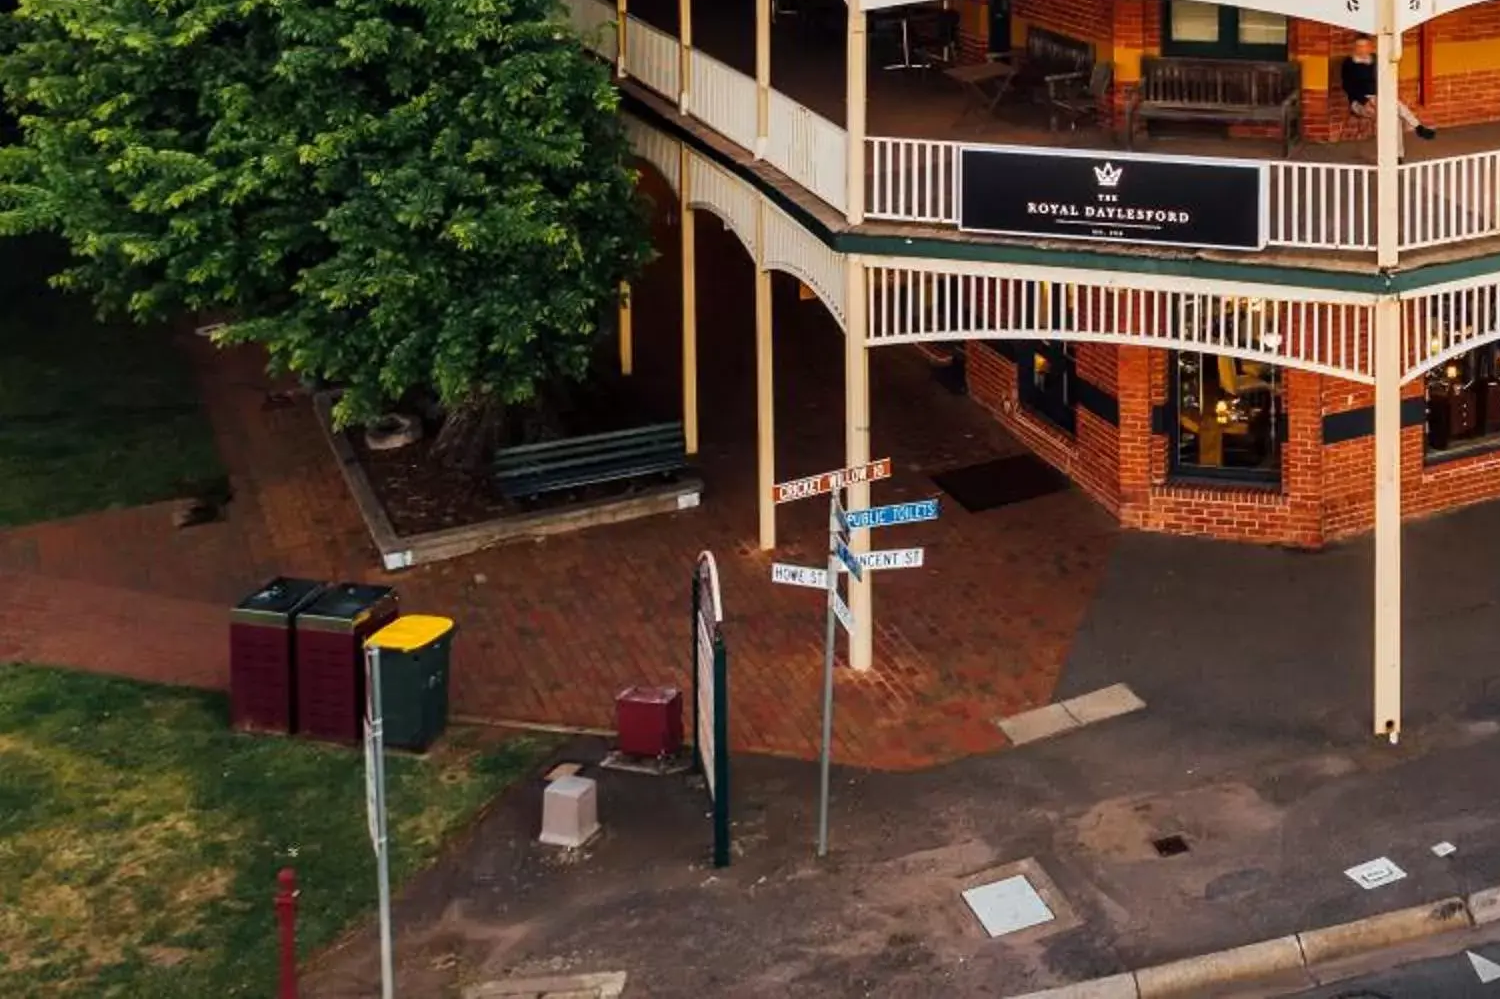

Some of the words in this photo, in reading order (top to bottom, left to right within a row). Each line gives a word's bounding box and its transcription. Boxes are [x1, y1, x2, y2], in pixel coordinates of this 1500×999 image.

[1026, 202, 1079, 217] ROYAL
[1085, 206, 1190, 224] DAYLESFORD
[847, 511, 885, 527] PUBLIC
[893, 501, 936, 520] TOILETS
[904, 550, 920, 563] ST
[809, 570, 823, 584] ST
